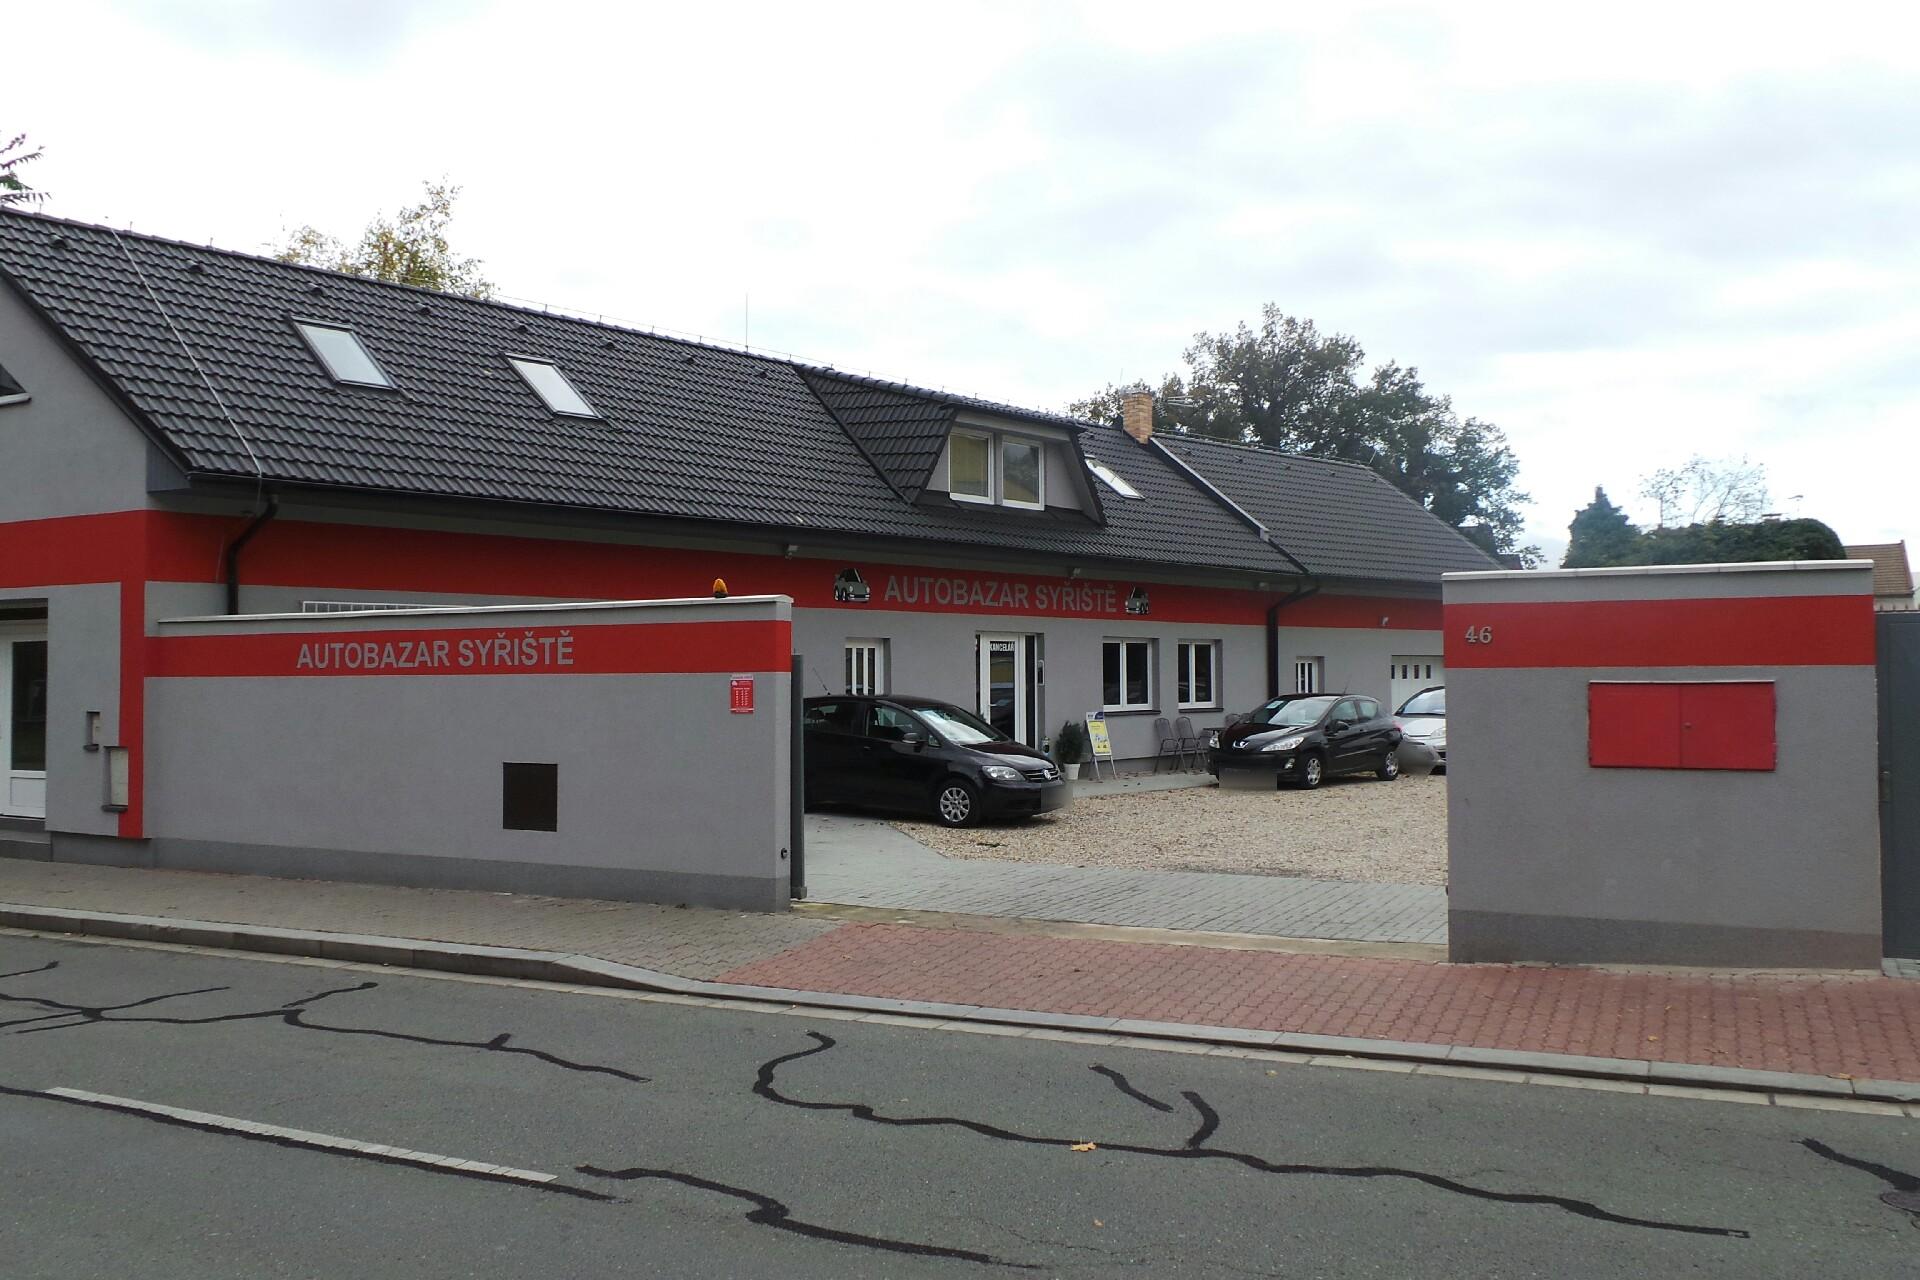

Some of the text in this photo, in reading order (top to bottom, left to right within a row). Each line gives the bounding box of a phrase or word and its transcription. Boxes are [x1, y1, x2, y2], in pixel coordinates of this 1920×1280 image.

[885, 575, 1117, 612] AUTOBAZAR SYŘIŠTĚ
[297, 630, 574, 669] AUTOBAZAR SYŘIŠTĚ
[1465, 625, 1492, 644] 46
